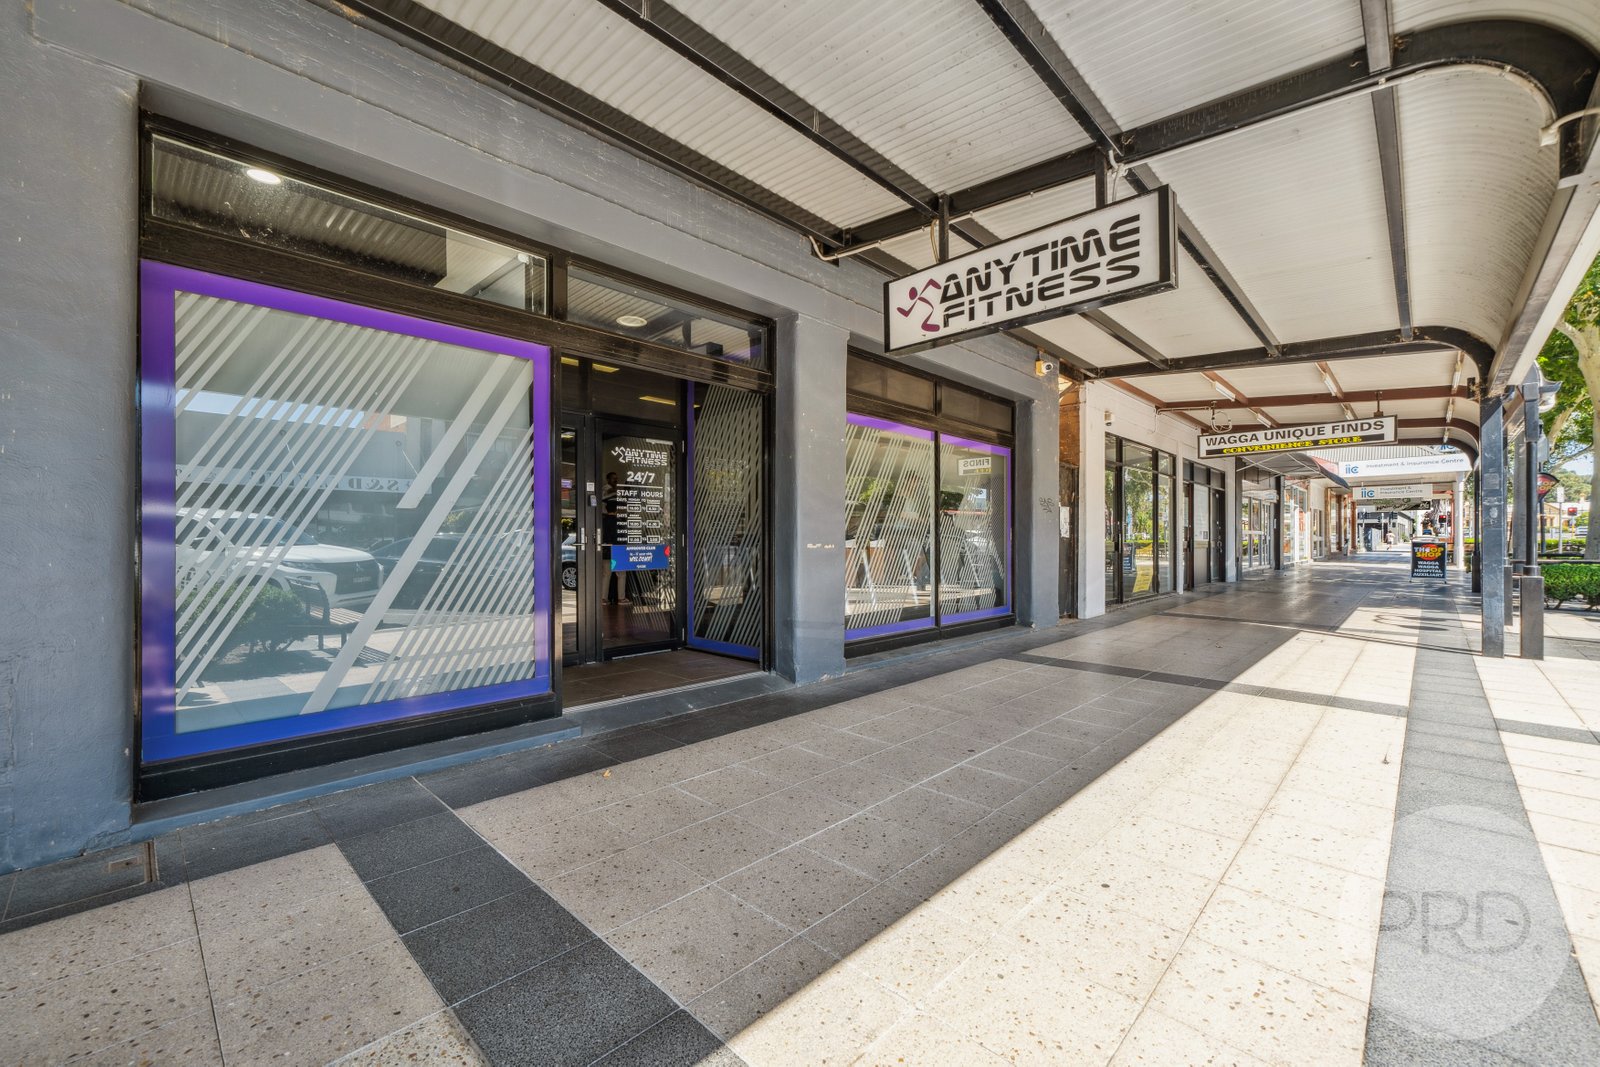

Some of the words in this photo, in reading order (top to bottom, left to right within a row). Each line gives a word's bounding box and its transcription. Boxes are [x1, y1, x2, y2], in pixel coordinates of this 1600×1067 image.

[939, 214, 1140, 304] ANYTIME
[943, 251, 1140, 328] FITNESS
[1205, 433, 1260, 447] WAGGA
[1264, 426, 1326, 441] UNIQUE
[1331, 420, 1385, 434] FINDS
[1318, 436, 1362, 446] STORE
[625, 448, 668, 460] ANYTIME
[626, 456, 668, 466] FITNESS
